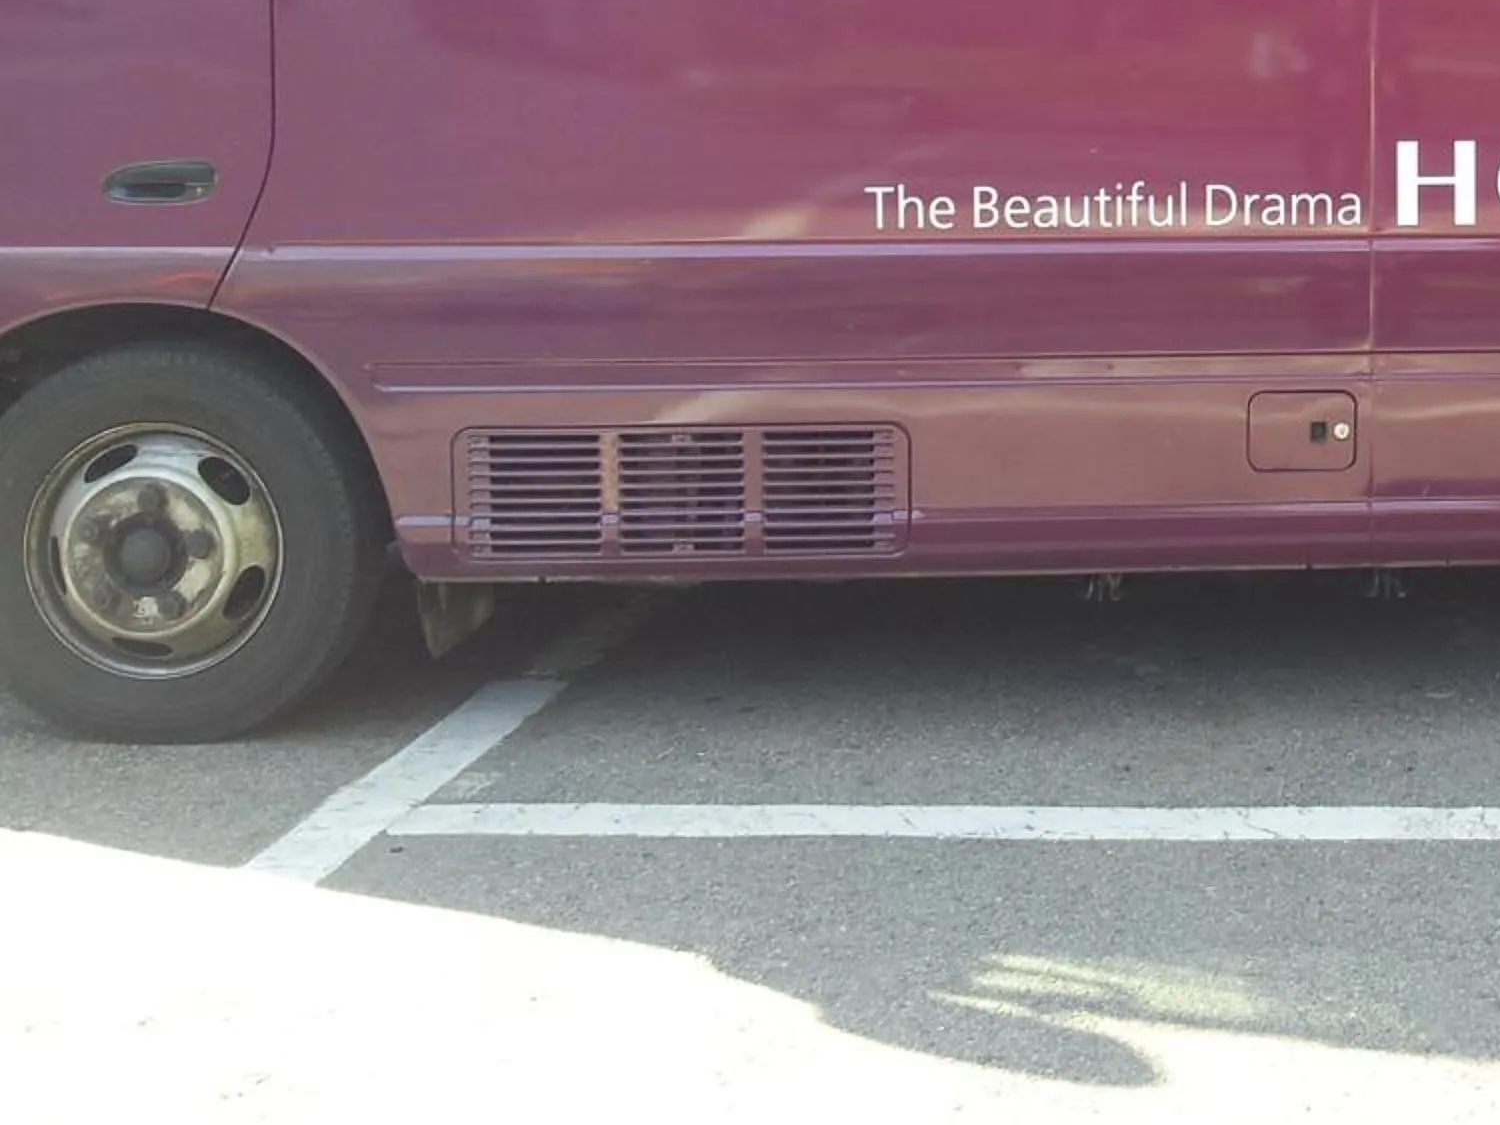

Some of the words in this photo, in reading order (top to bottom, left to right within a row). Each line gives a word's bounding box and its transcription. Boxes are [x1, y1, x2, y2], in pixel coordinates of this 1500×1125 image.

[865, 185, 955, 229] The
[973, 182, 1188, 229] Beautiful
[1206, 184, 1361, 226] Drama
